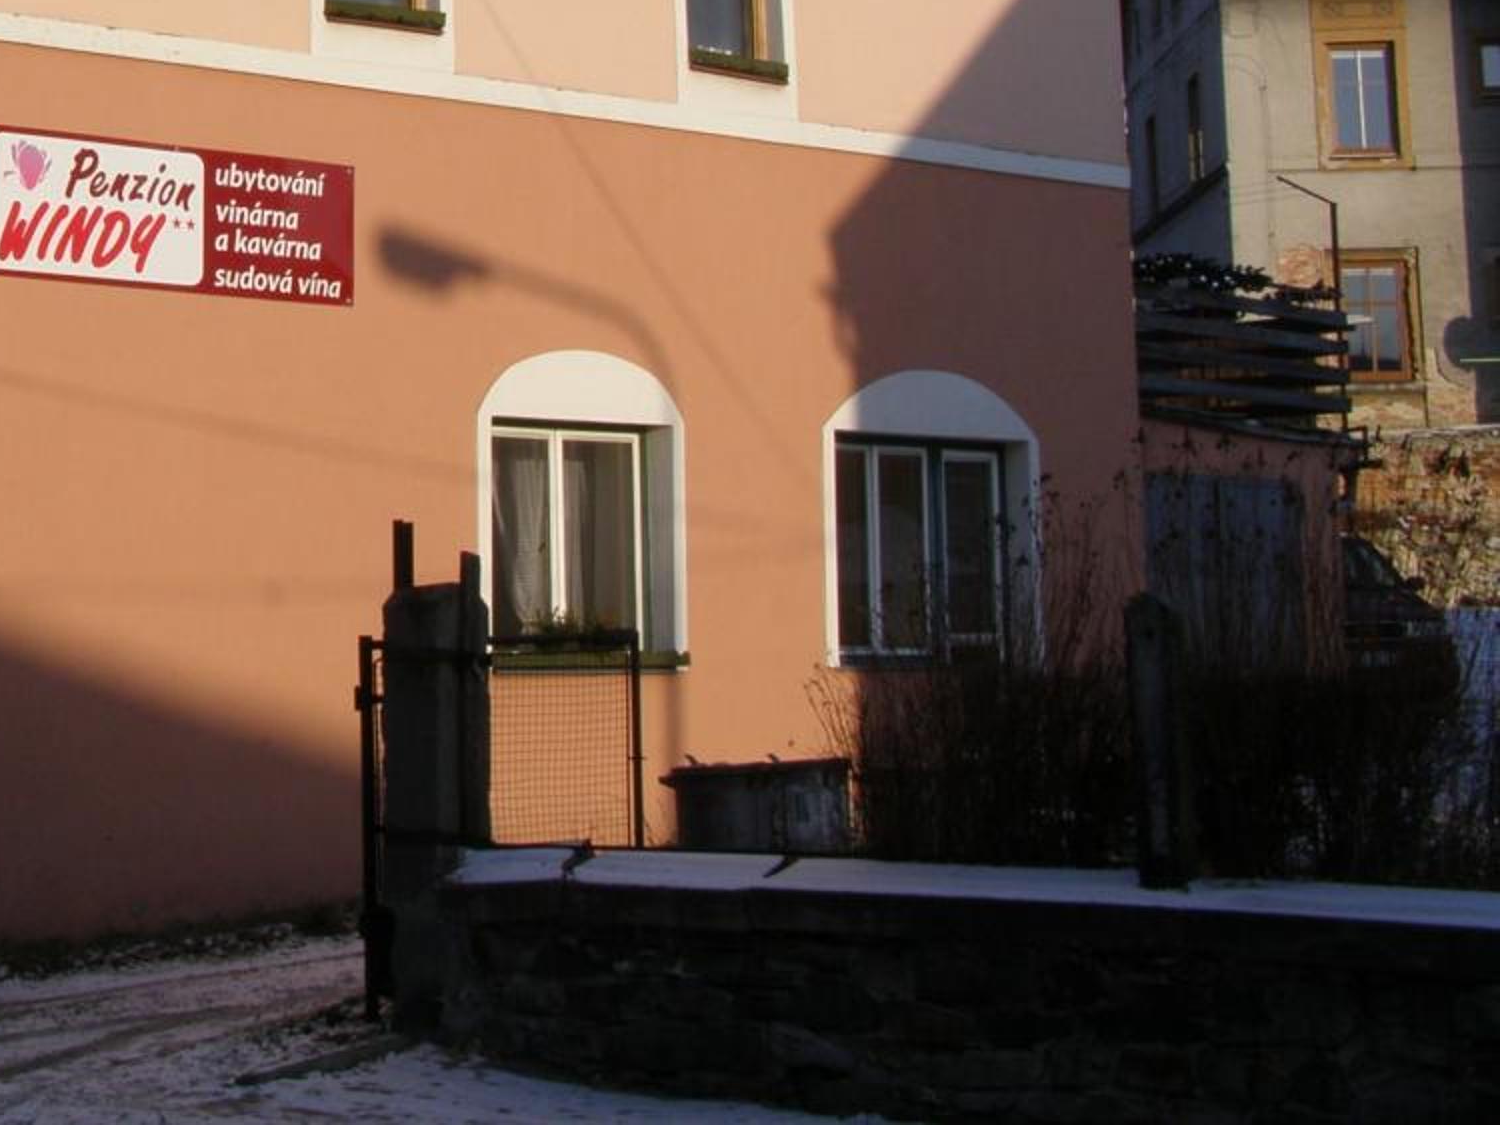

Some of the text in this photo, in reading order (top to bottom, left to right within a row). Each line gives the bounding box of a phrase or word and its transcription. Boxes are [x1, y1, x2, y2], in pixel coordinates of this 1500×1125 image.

[65, 148, 195, 211] Penzion
[215, 162, 325, 197] ubytování
[215, 198, 299, 230] vinárna
[215, 228, 322, 261] a kavárna
[214, 264, 342, 299] sudová vína
